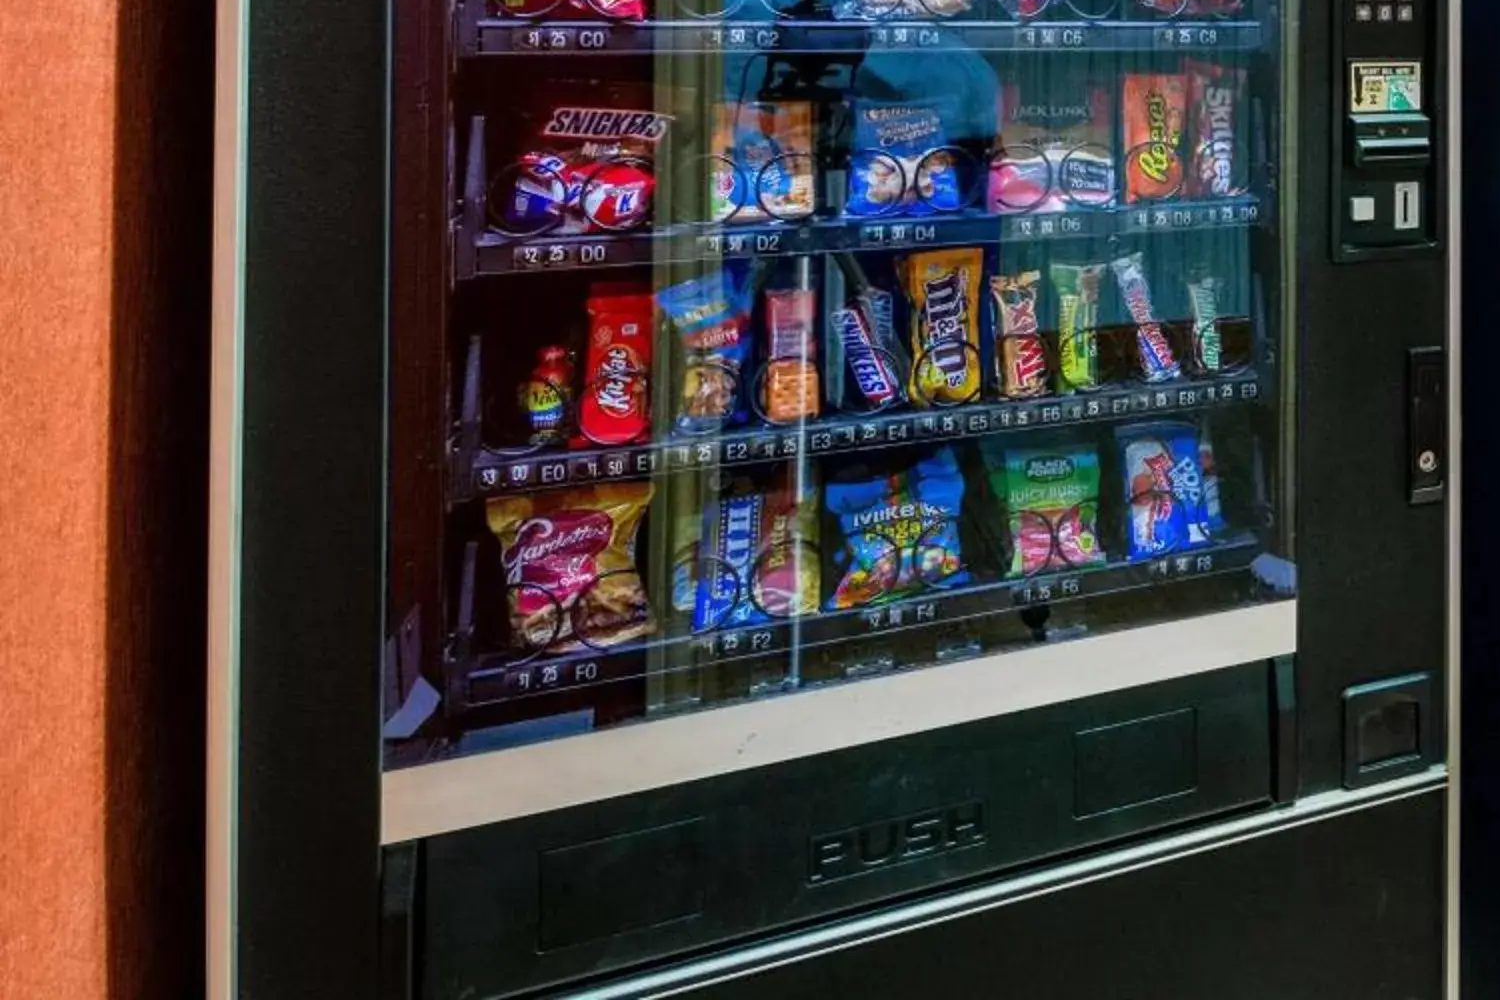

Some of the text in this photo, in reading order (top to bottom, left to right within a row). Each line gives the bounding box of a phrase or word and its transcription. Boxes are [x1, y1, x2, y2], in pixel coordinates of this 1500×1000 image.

[757, 31, 779, 48] C2
[918, 29, 939, 45] C4
[1063, 29, 1082, 45] C6
[549, 109, 666, 138] SNICKERS
[914, 225, 936, 242] D4
[757, 234, 780, 251] D2
[833, 308, 888, 394] SNICKERS
[1113, 400, 1129, 414] E7
[1179, 391, 1196, 406] E8
[887, 423, 907, 441] E4
[969, 415, 989, 432] E5
[811, 433, 831, 451] E3
[726, 442, 747, 460] E2
[1062, 579, 1079, 594] F6
[917, 602, 935, 621] F4
[752, 632, 771, 649] F2
[808, 800, 985, 883] PUSH
